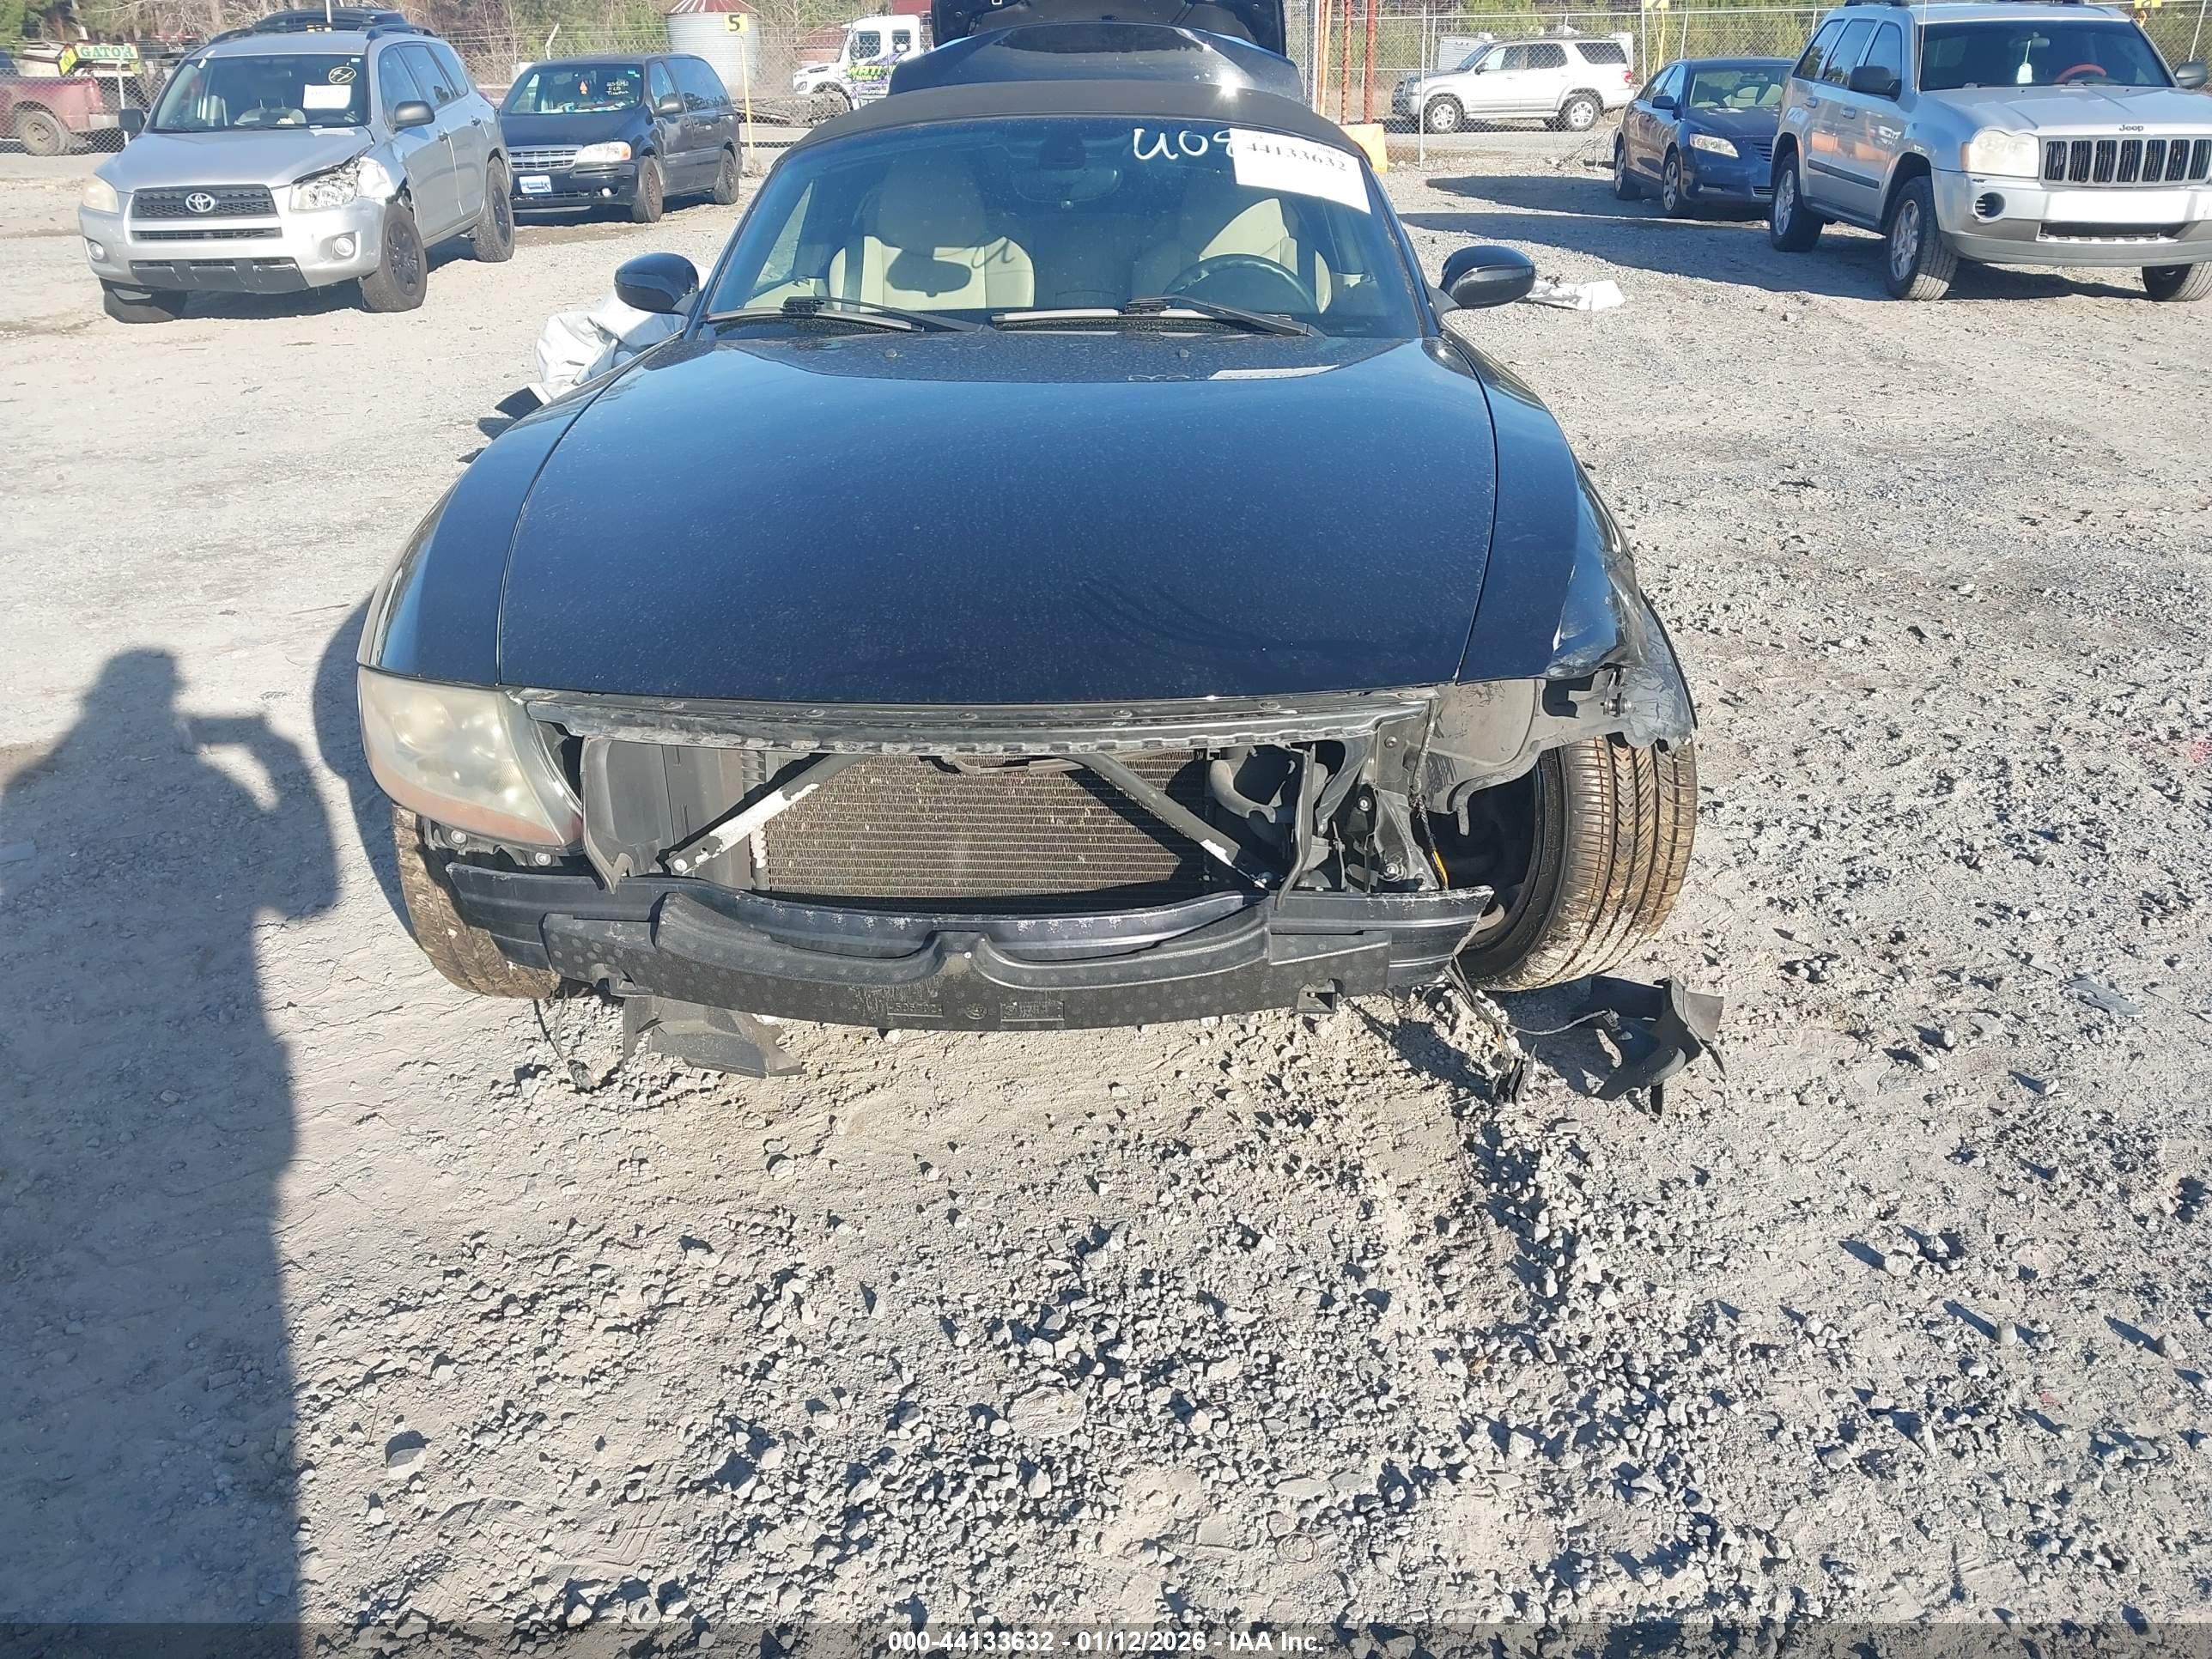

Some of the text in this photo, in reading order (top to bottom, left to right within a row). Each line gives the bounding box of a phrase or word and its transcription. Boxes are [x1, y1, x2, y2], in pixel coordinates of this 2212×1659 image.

[728, 14, 740, 32] 5
[79, 46, 135, 57] GATOR
[2118, 124, 2144, 132] Jeep
[1246, 142, 1347, 172] 44133632
